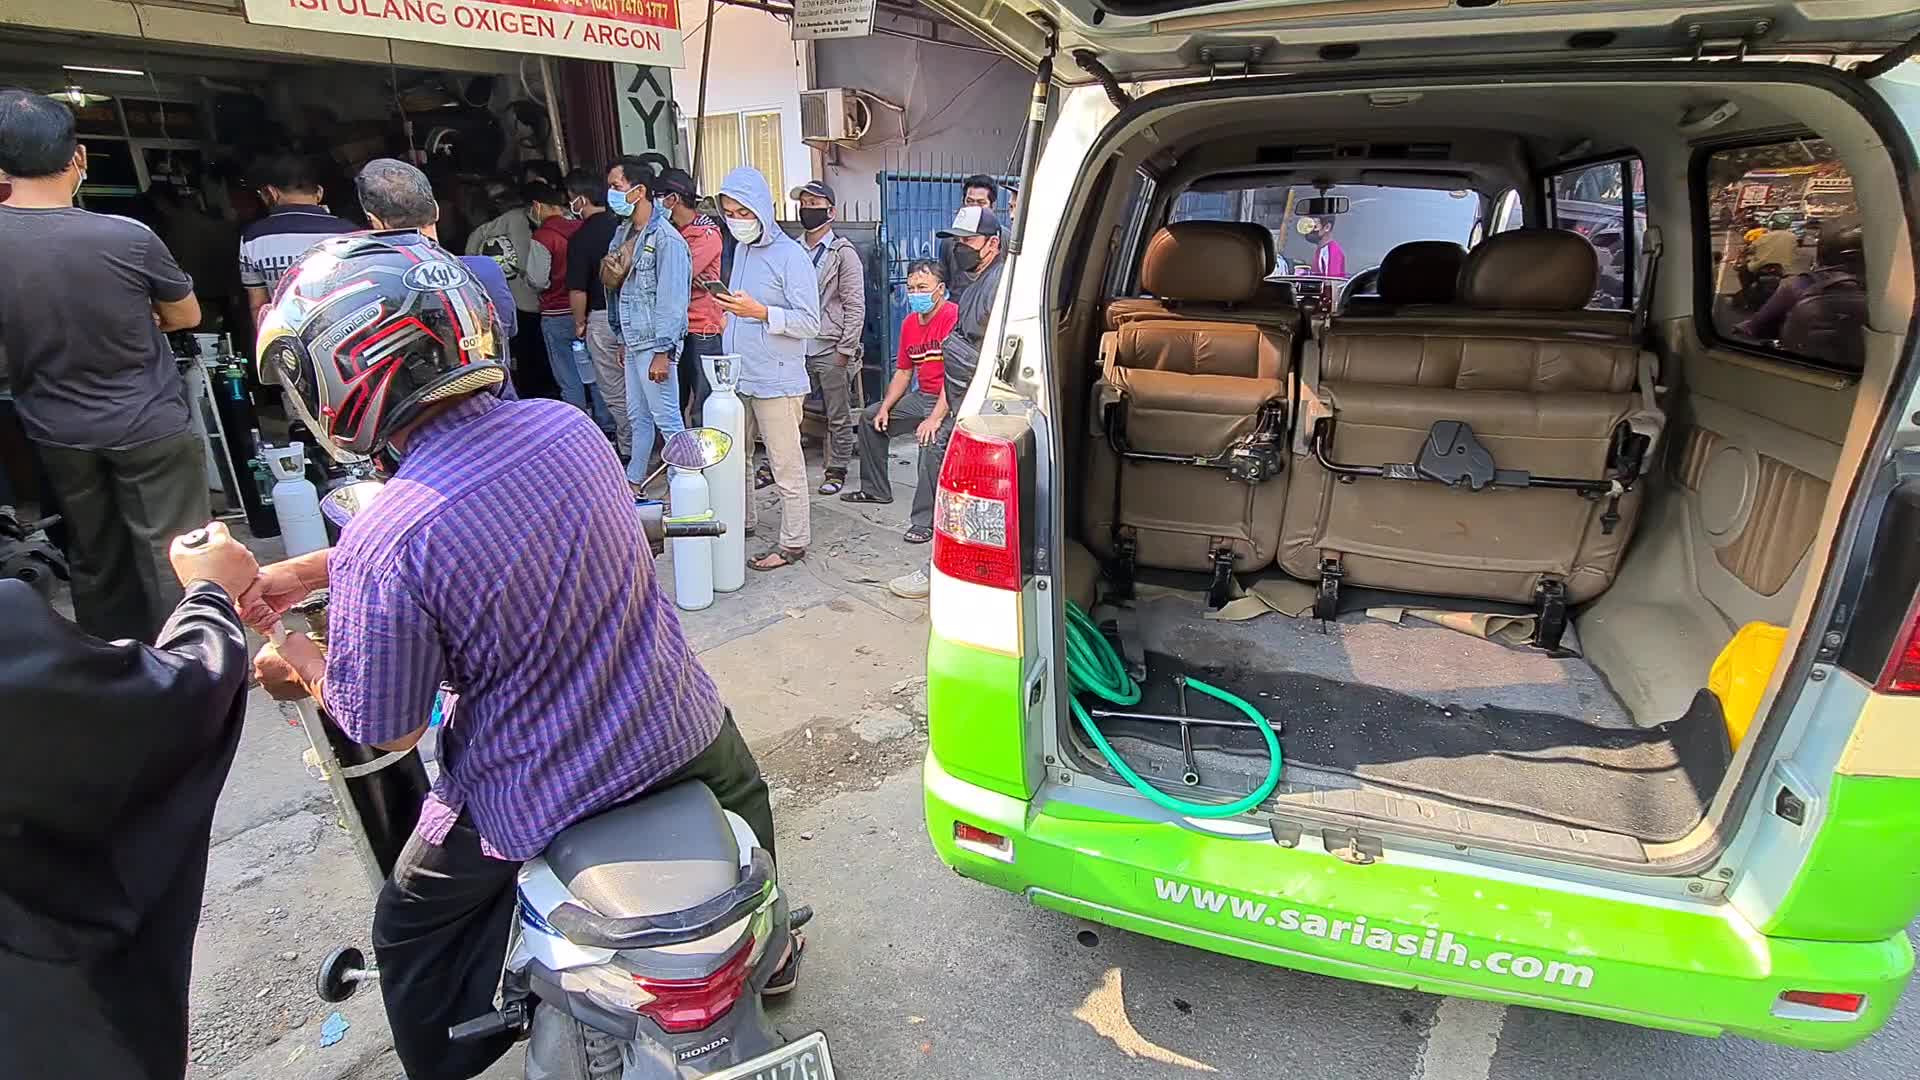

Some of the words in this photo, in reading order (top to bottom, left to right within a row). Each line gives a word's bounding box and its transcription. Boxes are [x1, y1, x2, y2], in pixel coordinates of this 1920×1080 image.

[337, 0, 447, 25] ULANG
[455, 6, 556, 38] OXIGEN
[584, 23, 661, 51] ARGON
[1153, 876, 1594, 990] www.sariasih.com
[680, 1036, 729, 1060] HONDA
